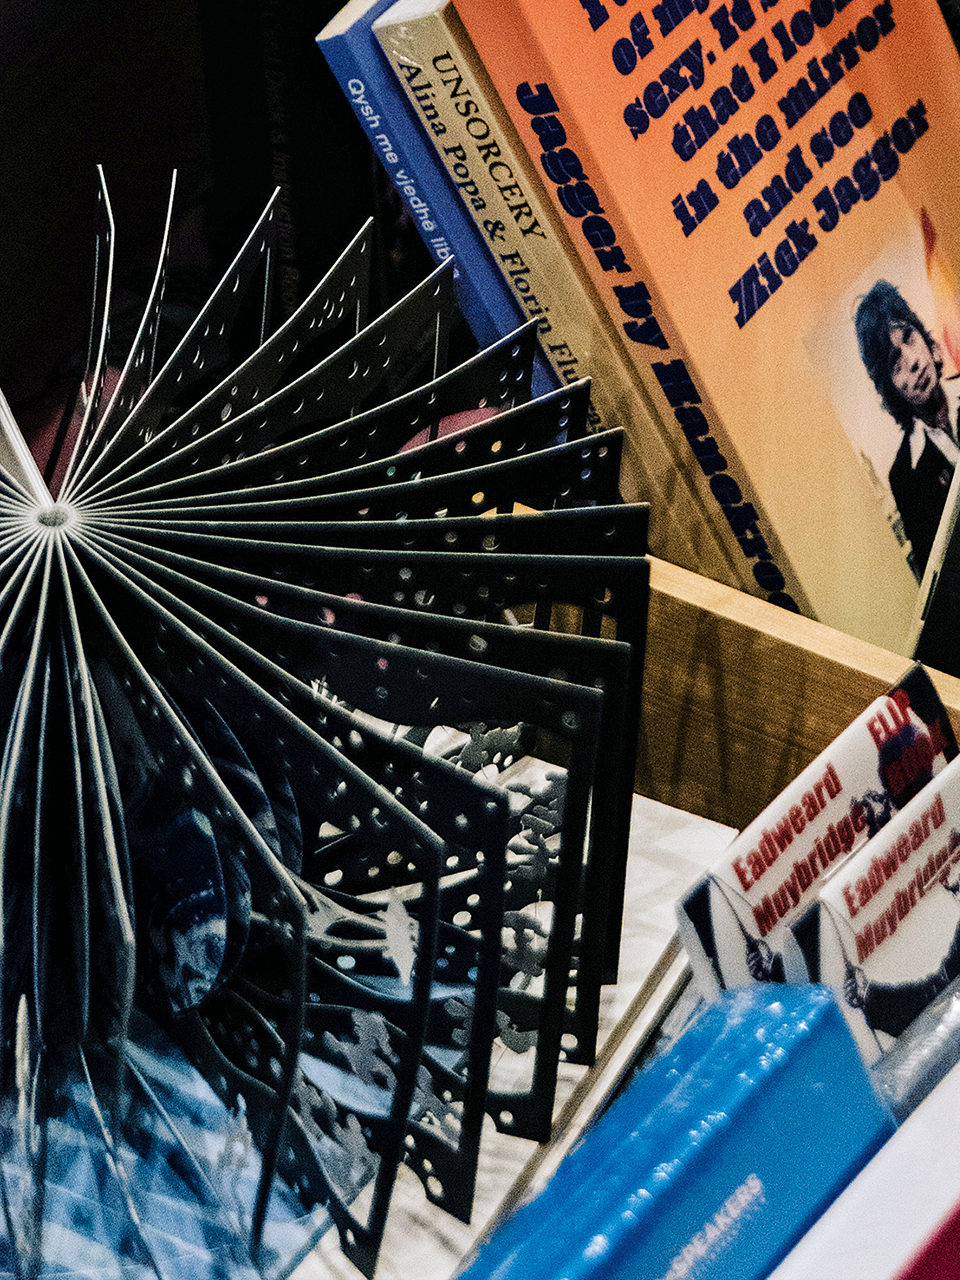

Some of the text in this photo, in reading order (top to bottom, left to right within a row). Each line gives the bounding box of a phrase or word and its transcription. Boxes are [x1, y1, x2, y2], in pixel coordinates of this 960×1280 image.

[612, 11, 654, 75] of
[624, 38, 716, 141] sexy.
[672, 63, 755, 162] that
[749, 37, 778, 84] I
[348, 77, 381, 129] Qysh
[374, 132, 398, 164] me
[394, 169, 438, 232] vjedhë
[398, 61, 448, 137] Alina
[443, 143, 487, 211] Popa
[483, 219, 506, 242] &
[500, 250, 553, 334] Florin
[432, 50, 547, 240] UNSORCERY
[672, 178, 720, 238] in
[716, 114, 781, 190] the
[743, 92, 873, 238] and see
[516, 81, 632, 273] Jagger
[613, 280, 670, 348] by
[728, 98, 929, 329] Mick Jagger
[866, 688, 912, 750] FLIP
[733, 761, 843, 892] Eadweard
[752, 801, 868, 937] Muybridge
[842, 795, 946, 918] Eadweard
